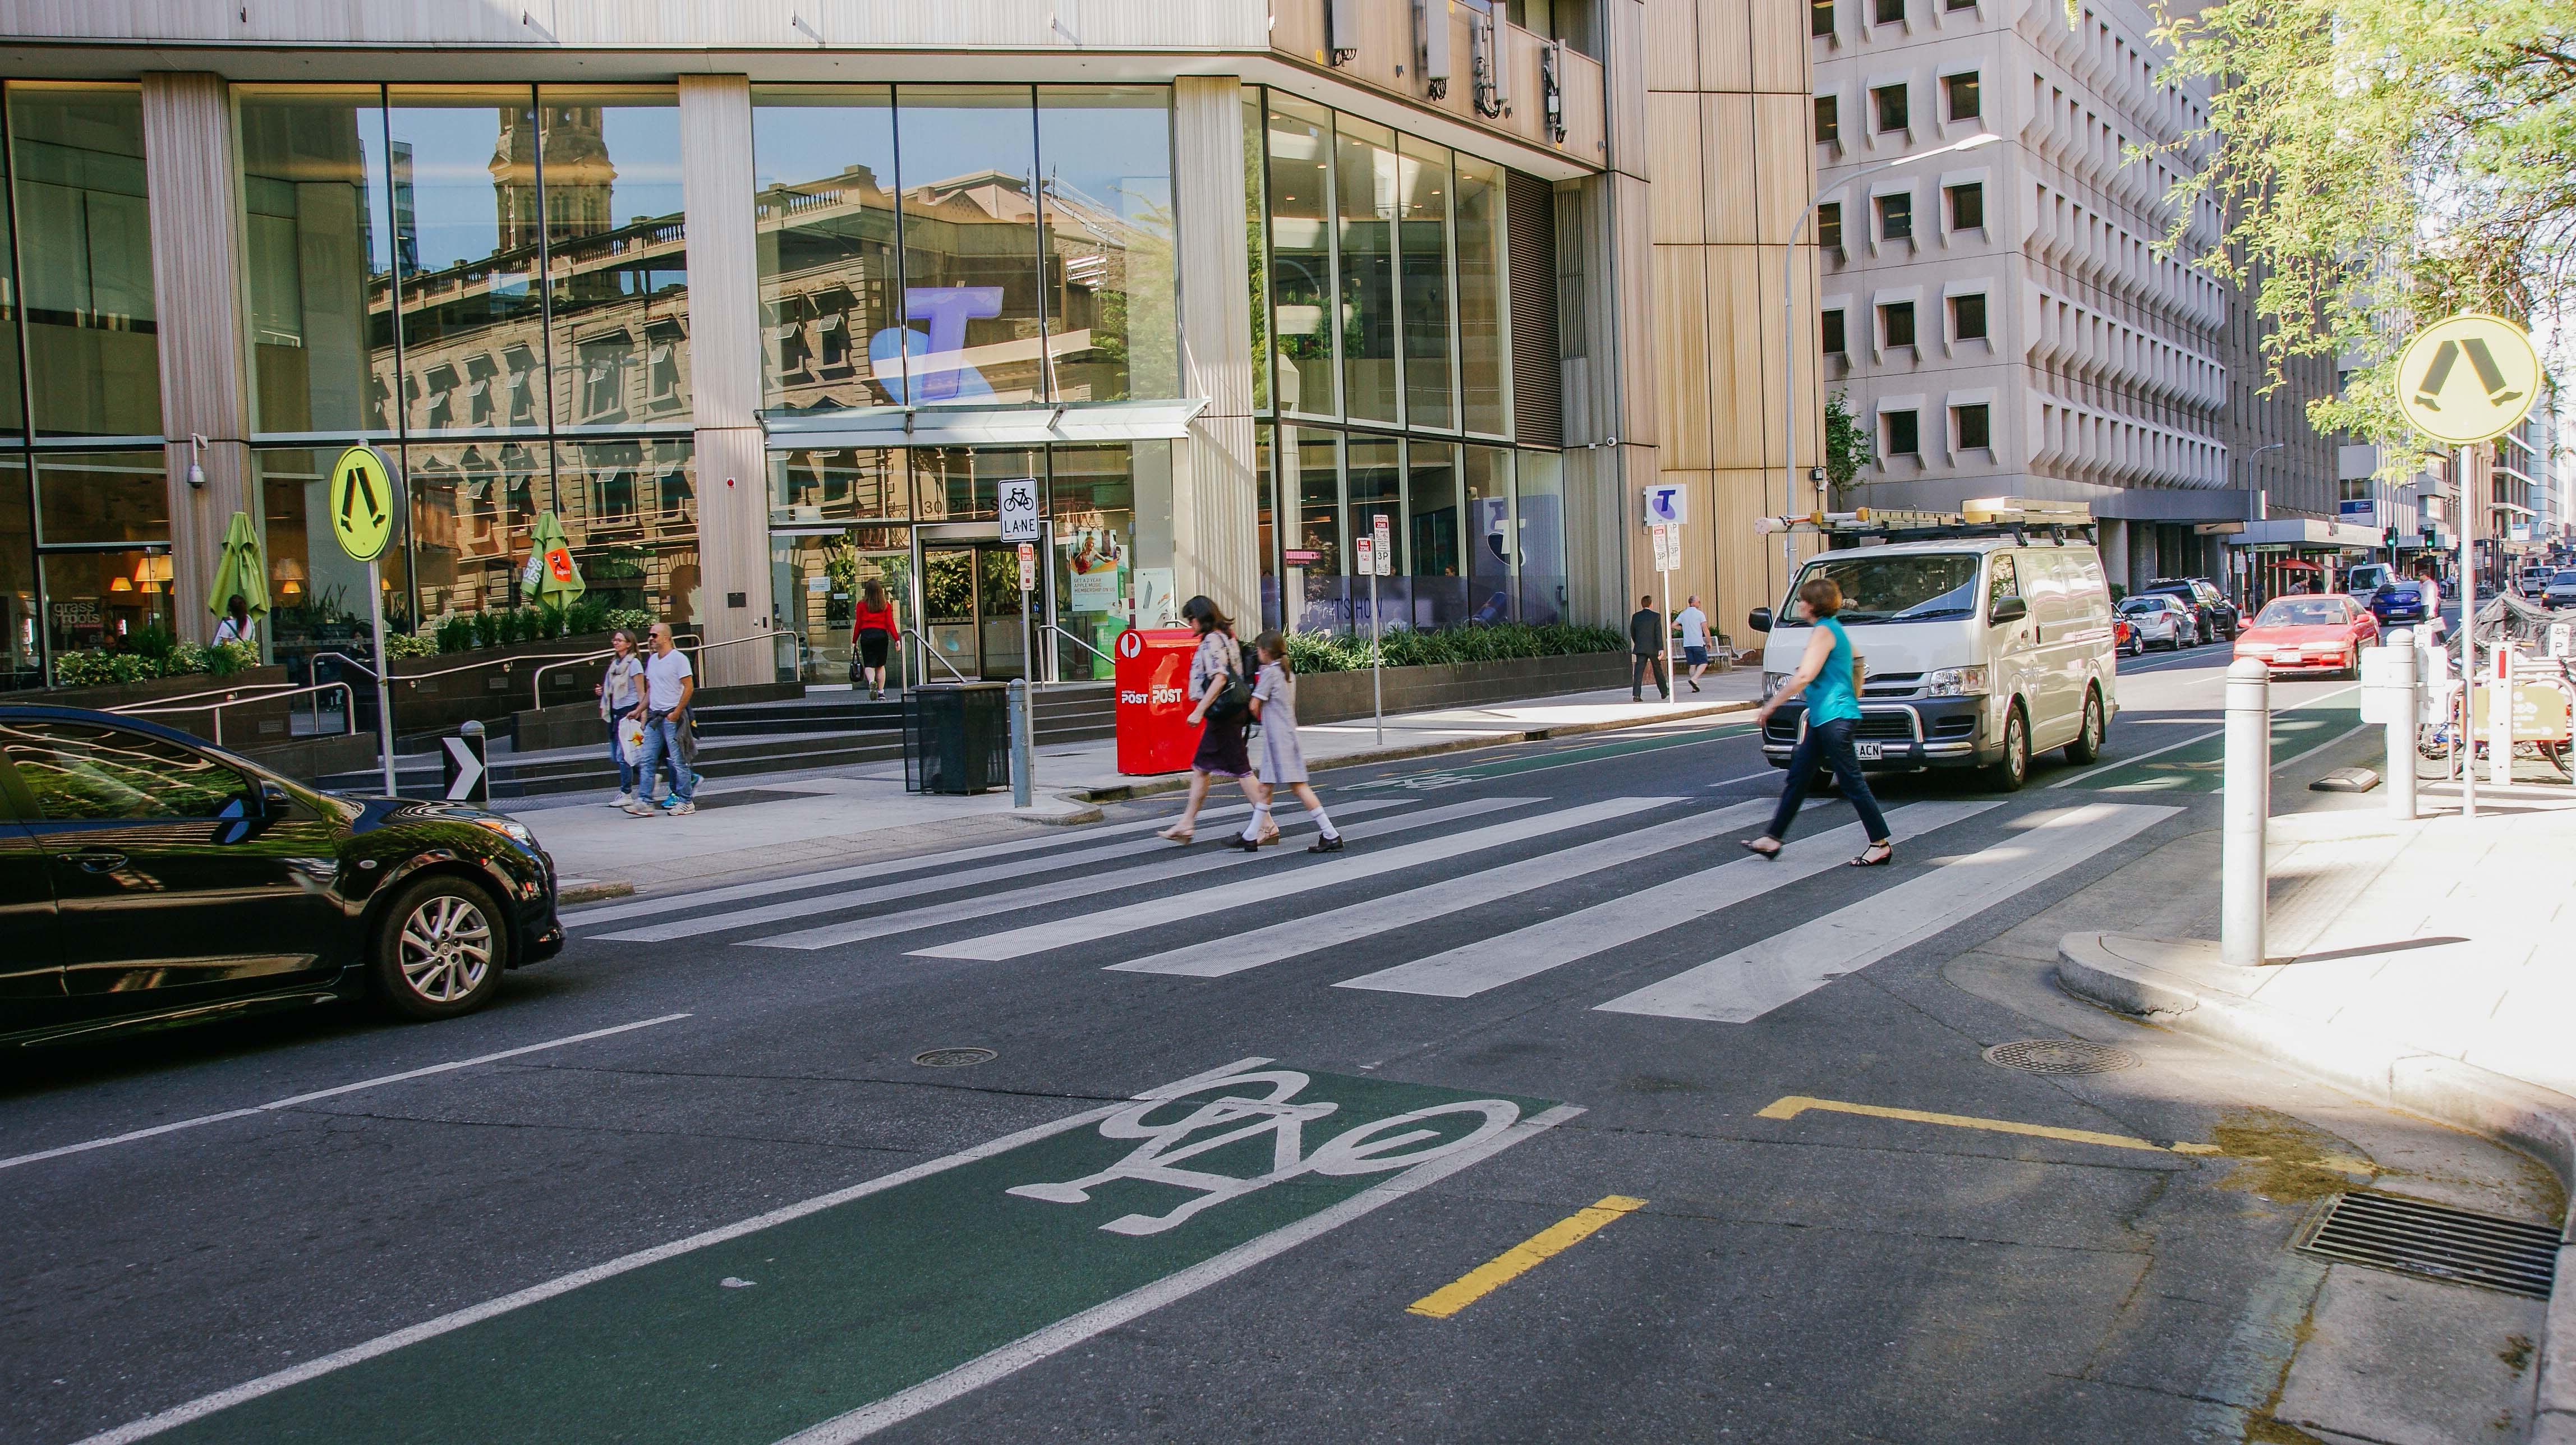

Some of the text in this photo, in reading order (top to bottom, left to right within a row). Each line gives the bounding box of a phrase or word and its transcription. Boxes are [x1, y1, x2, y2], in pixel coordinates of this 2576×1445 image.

[924, 500, 942, 513] 30
[1657, 490, 1676, 512] T
[1005, 518, 1035, 533] LANE
[54, 603, 95, 616] grass
[62, 613, 100, 624] roots
[2555, 642, 2563, 651] P
[1121, 693, 1148, 704] POST
[1153, 688, 1182, 704] POST
[1860, 745, 1879, 756] ACN
